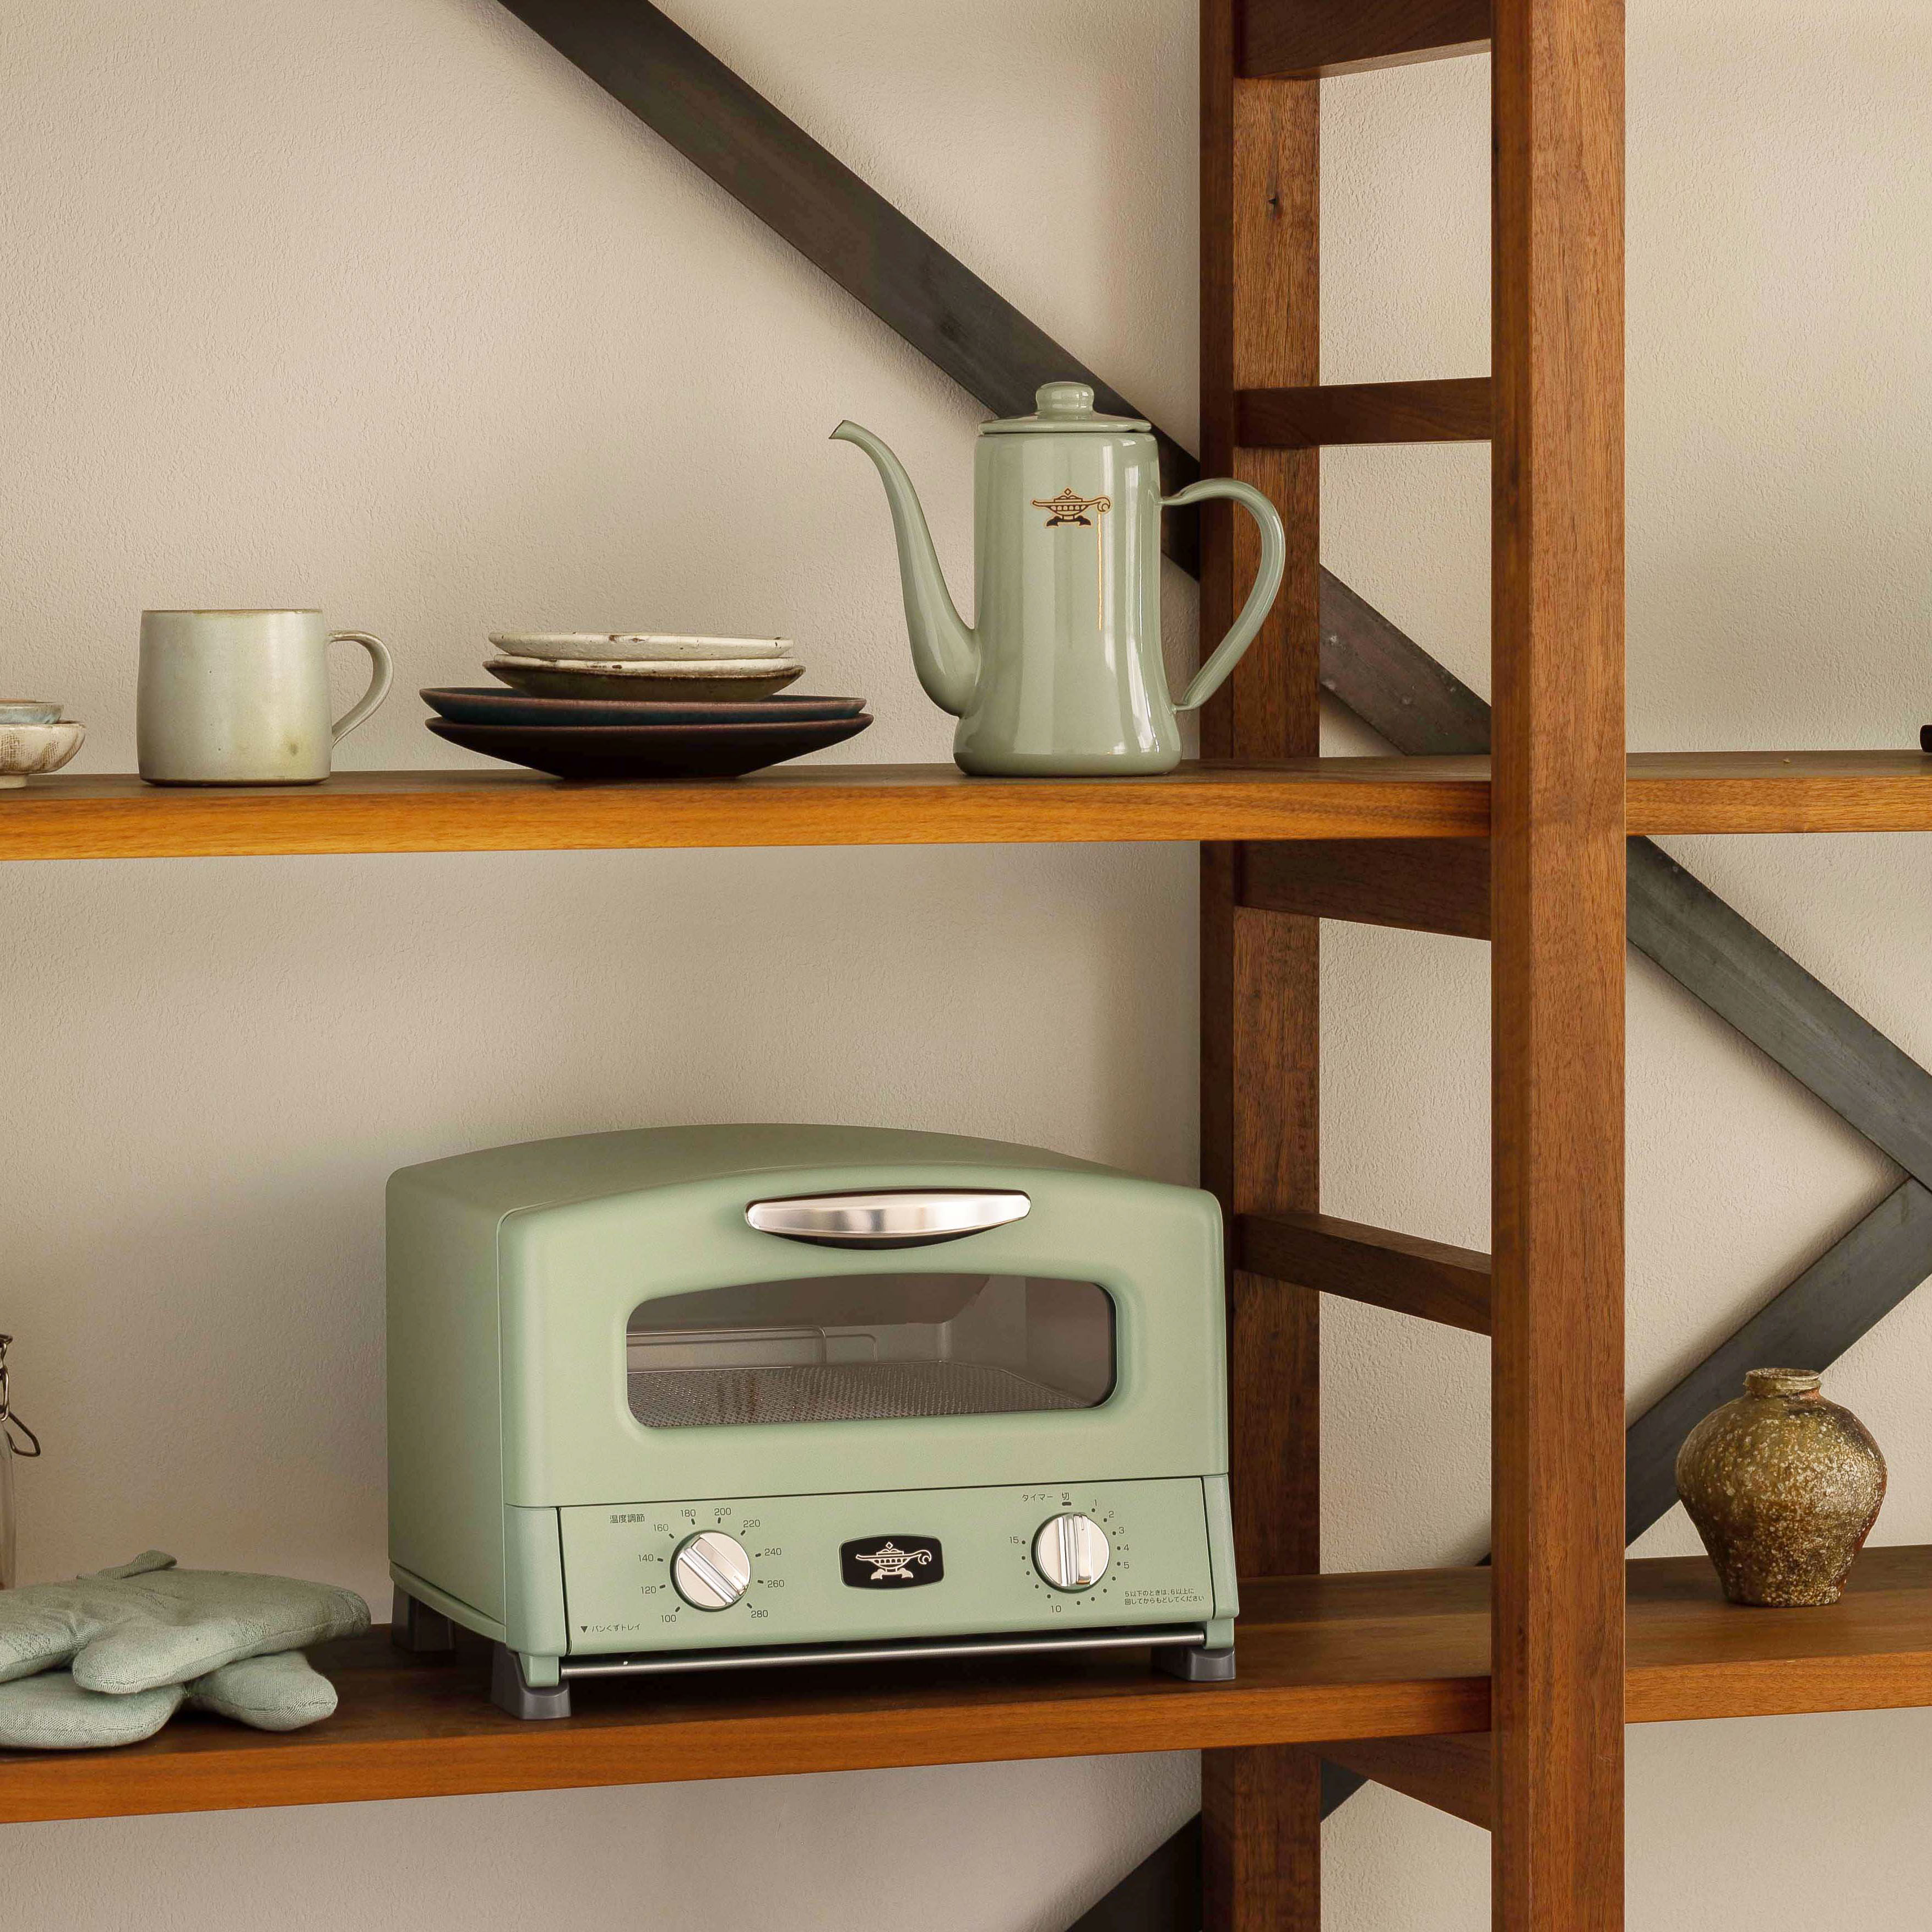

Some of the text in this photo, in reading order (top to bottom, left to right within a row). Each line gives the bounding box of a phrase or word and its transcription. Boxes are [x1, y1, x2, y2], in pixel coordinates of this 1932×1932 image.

[1022, 1493, 1053, 1502] タイマー
[1061, 1492, 1070, 1501] 切
[680, 1509, 696, 1517] 180
[714, 1508, 731, 1516] 200
[609, 1513, 645, 1524] 温度調節
[653, 1523, 669, 1532] 160
[743, 1519, 761, 1528] 220
[1119, 1526, 1125, 1534] 3
[1009, 1536, 1019, 1544] 15
[764, 1548, 782, 1556] 240
[638, 1554, 654, 1562] 140
[767, 1580, 785, 1588] 260
[641, 1586, 656, 1594] 120
[1051, 1605, 1062, 1613] 10
[661, 1614, 677, 1623] 100
[751, 1610, 768, 1619] 280
[591, 1623, 640, 1632] パンくずトレイ
